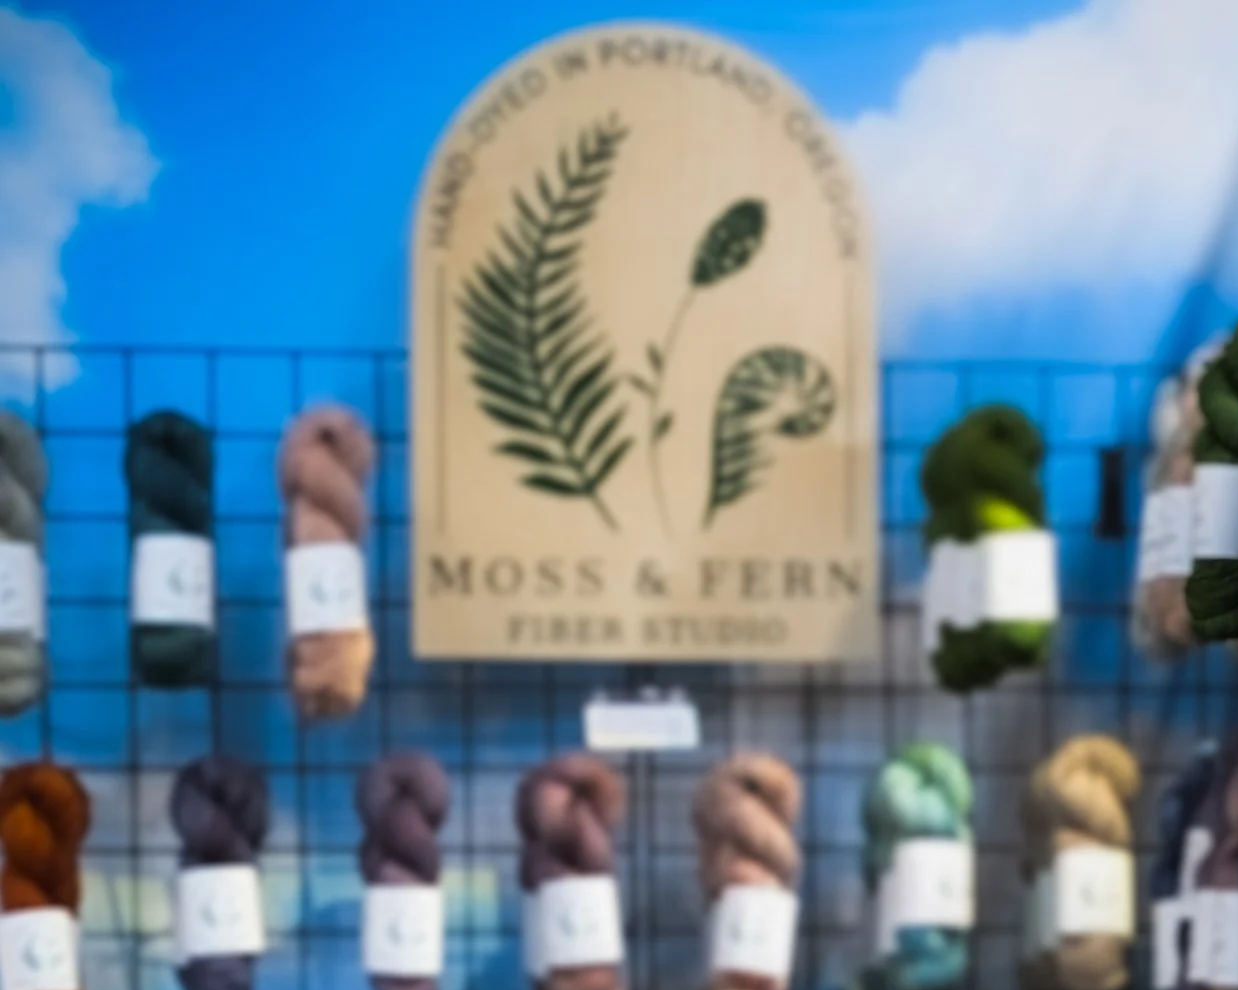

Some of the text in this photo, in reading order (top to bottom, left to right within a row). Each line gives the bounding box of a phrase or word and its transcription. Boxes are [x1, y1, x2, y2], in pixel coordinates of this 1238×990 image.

[555, 49, 589, 81] IN
[428, 556, 864, 599] MOSS & FERN
[506, 614, 788, 646] FIBER STUDIO
